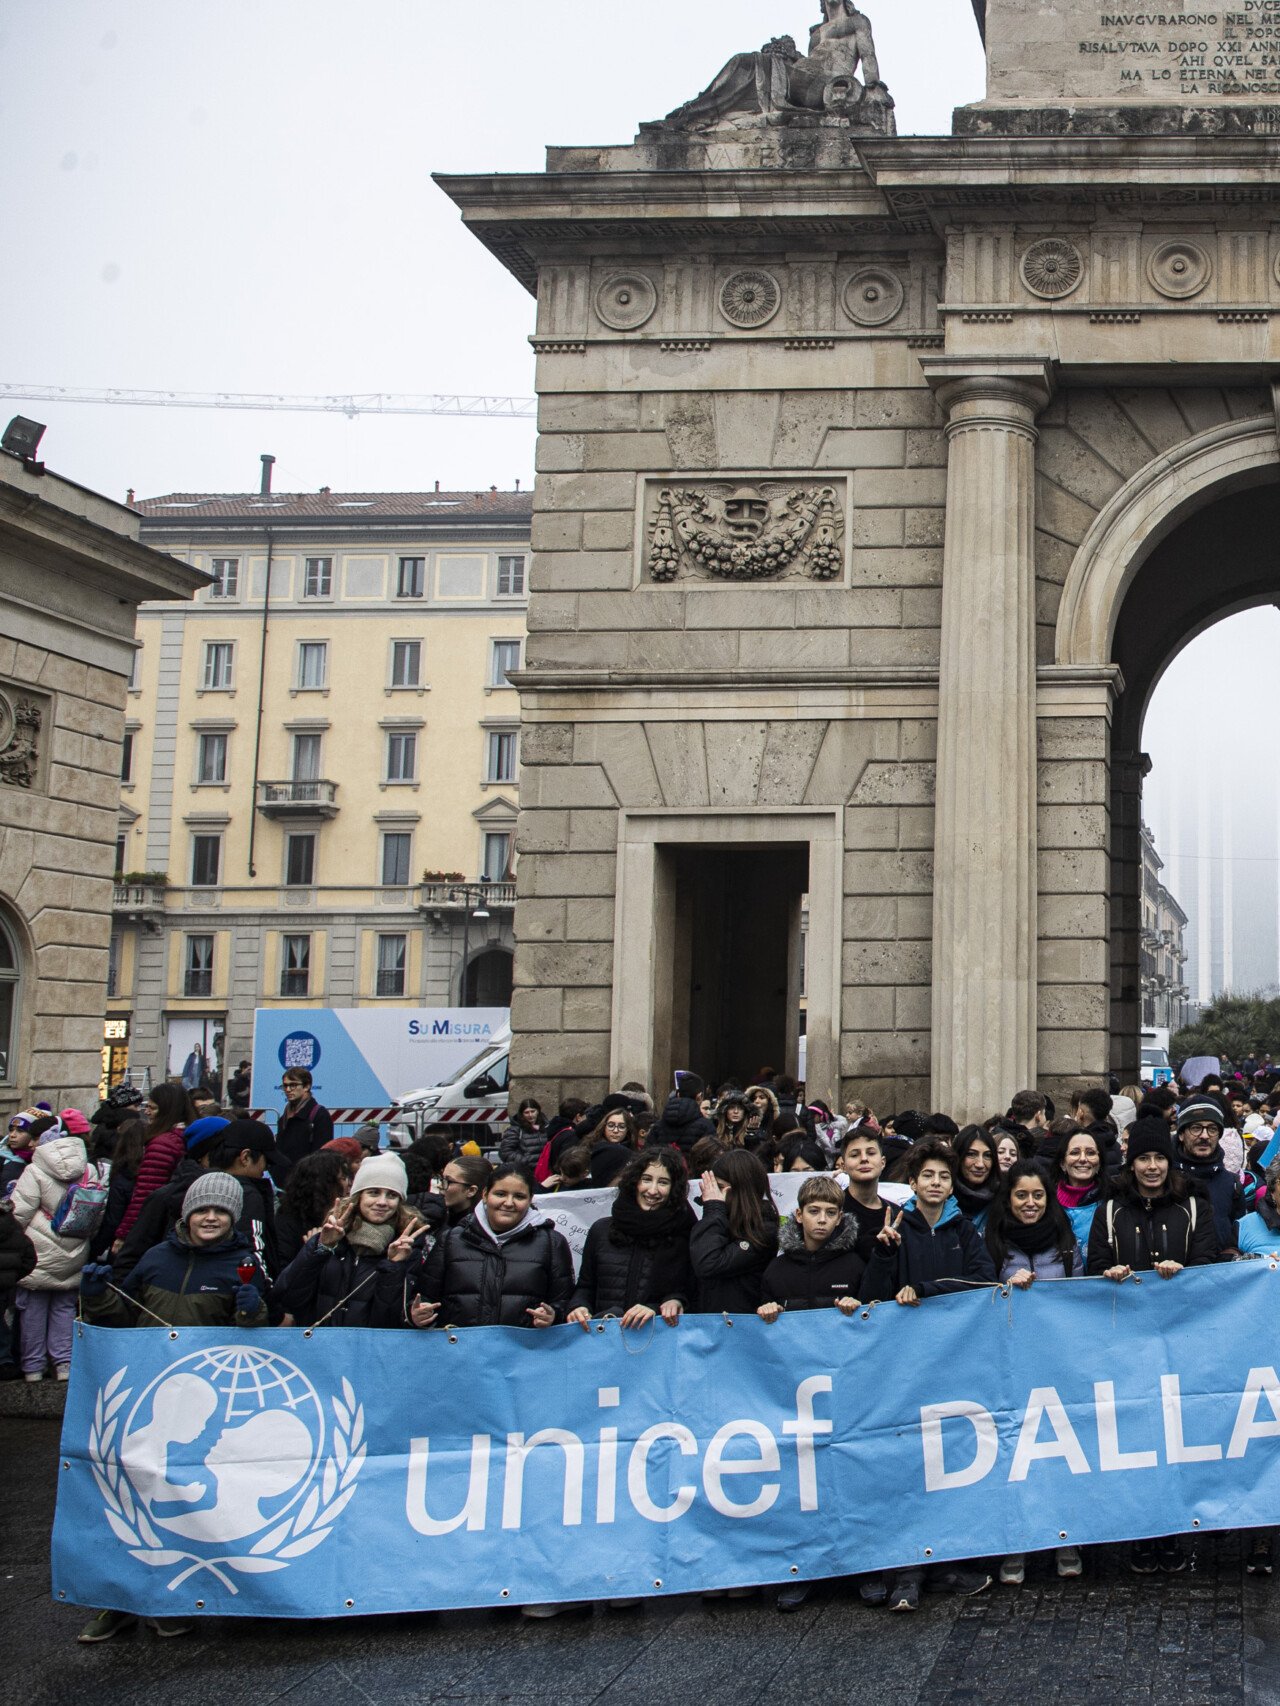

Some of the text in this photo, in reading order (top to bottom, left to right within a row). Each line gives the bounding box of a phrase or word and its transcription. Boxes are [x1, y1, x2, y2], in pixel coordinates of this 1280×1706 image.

[1245, 0, 1280, 11] DVCE
[1101, 14, 1218, 26] INAVGVRARONO
[1226, 14, 1253, 25] NEL
[1224, 27, 1238, 39] IL
[1079, 42, 1161, 53] RISALVTAVA
[1168, 42, 1208, 52] DOPO
[1217, 42, 1242, 52] XXI
[1180, 56, 1204, 66] AHI
[1213, 55, 1253, 66] QVEL
[1120, 70, 1142, 80] MA
[1152, 69, 1171, 80] LO
[1180, 69, 1236, 80] ETERNA
[1245, 69, 1267, 80] NEI
[1181, 83, 1199, 94] LA
[405, 1375, 833, 1536] unicef
